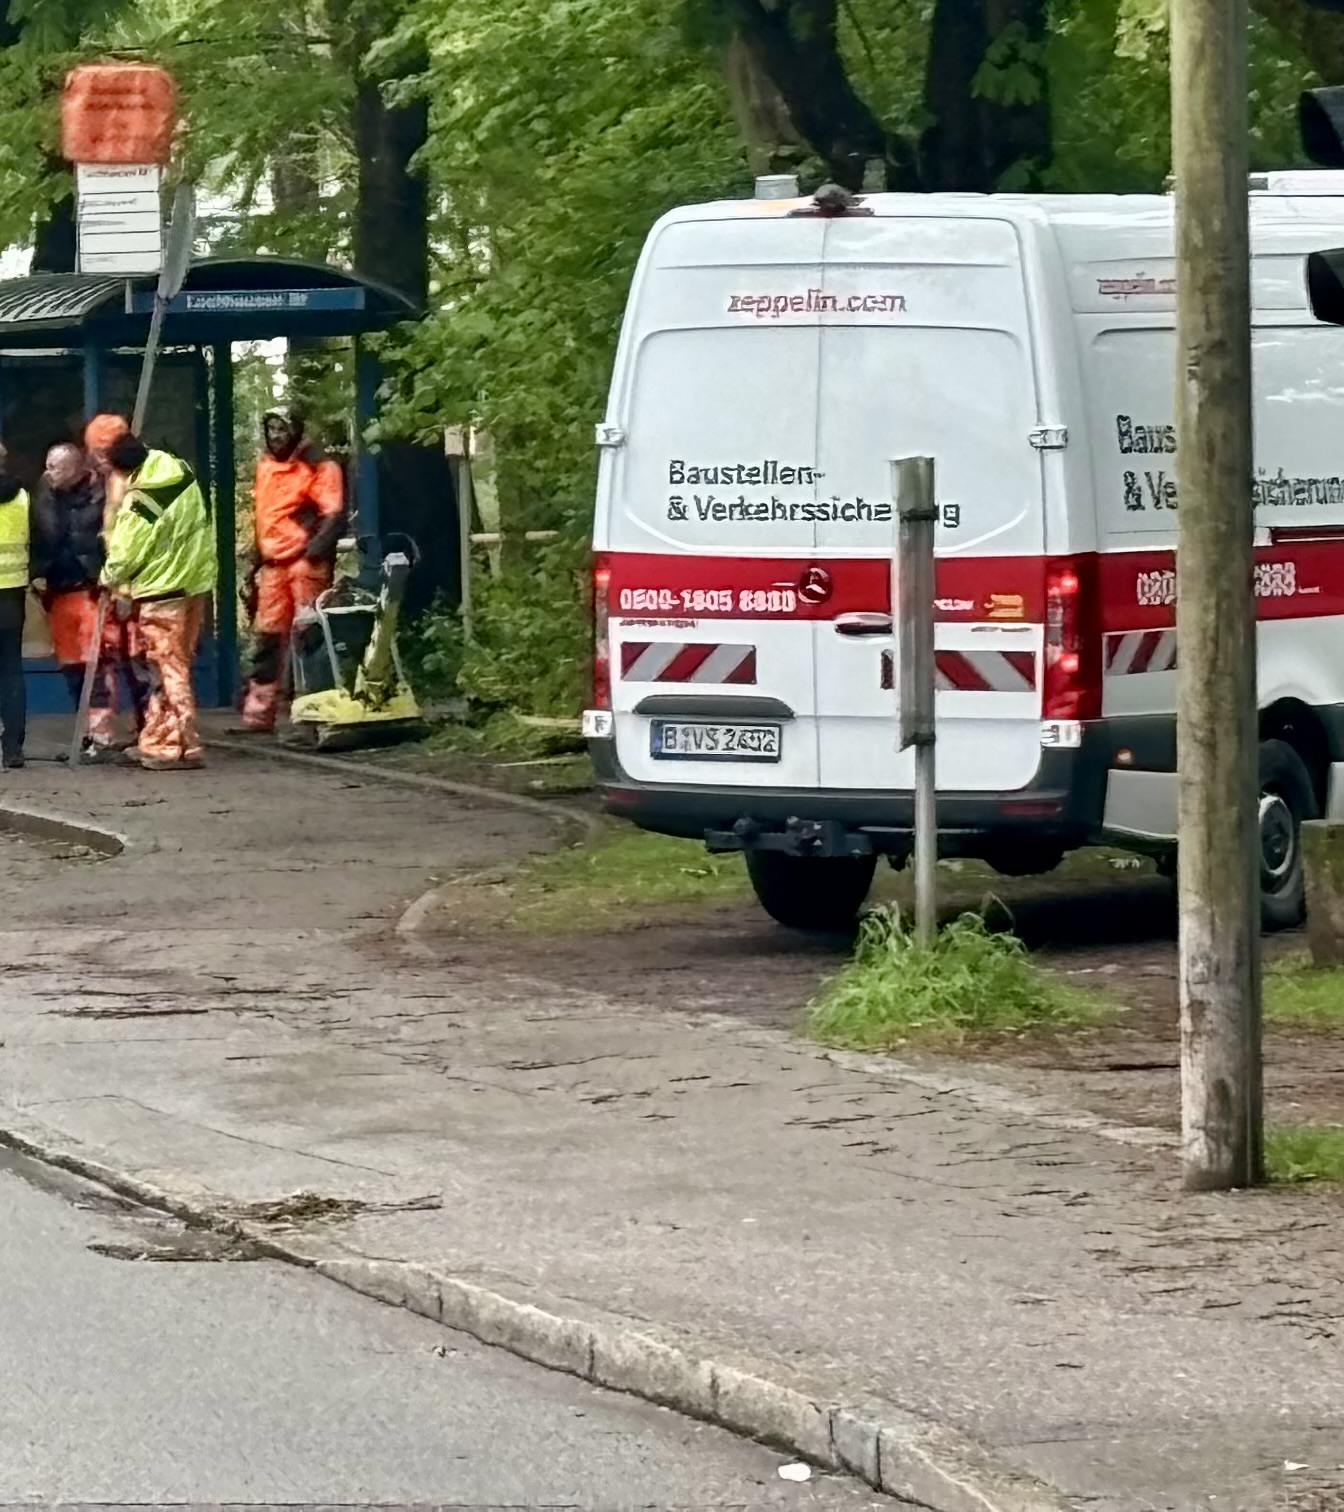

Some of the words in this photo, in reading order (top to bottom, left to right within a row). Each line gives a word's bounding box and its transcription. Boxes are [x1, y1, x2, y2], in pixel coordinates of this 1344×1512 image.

[727, 288, 908, 319] zeppelin.com
[669, 459, 825, 485] Baustellen-
[668, 495, 689, 522] &
[693, 494, 960, 528] Verkehrssicheg
